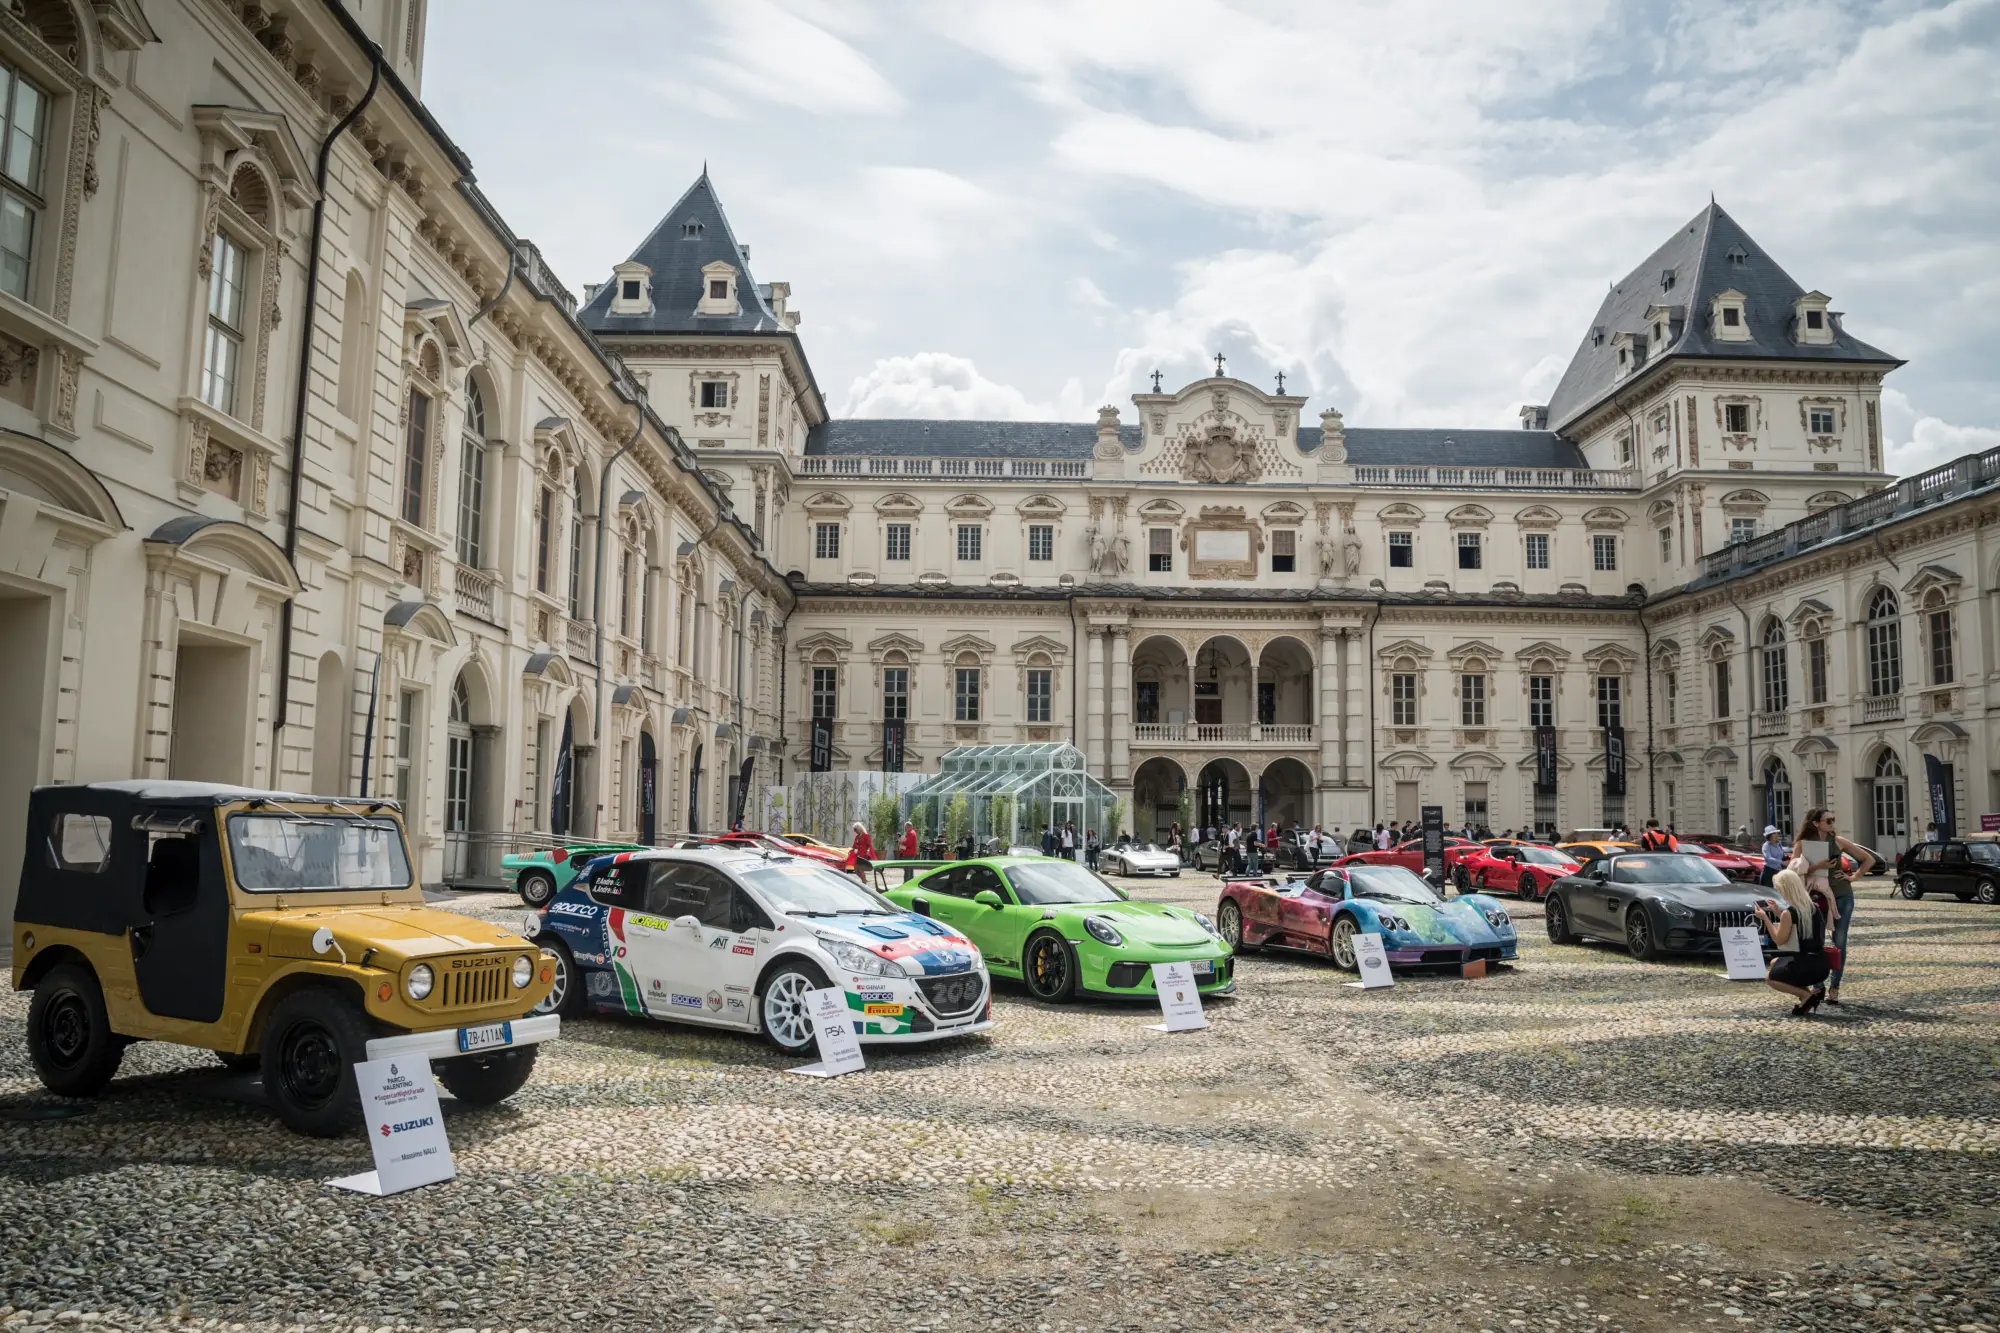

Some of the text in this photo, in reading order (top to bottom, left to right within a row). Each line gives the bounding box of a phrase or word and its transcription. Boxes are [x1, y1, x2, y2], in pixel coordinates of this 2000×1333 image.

[551, 902, 598, 916] sparco
[629, 914, 670, 931] LORAN
[611, 945, 627, 958] 10
[732, 946, 754, 956] TOTAL
[452, 956, 506, 969] SUZUKI
[932, 979, 978, 1004] 208
[672, 994, 702, 1006] sparco
[726, 997, 745, 1009] PSA
[867, 1005, 900, 1014] PIRELLI
[825, 1025, 846, 1038] PSA
[382, 1081, 413, 1091] VALENTINO
[387, 1076, 406, 1084] PARCO
[393, 1116, 434, 1133] SUZUKI
[401, 1151, 423, 1161] Massimo
[423, 1146, 438, 1156] NALLI
